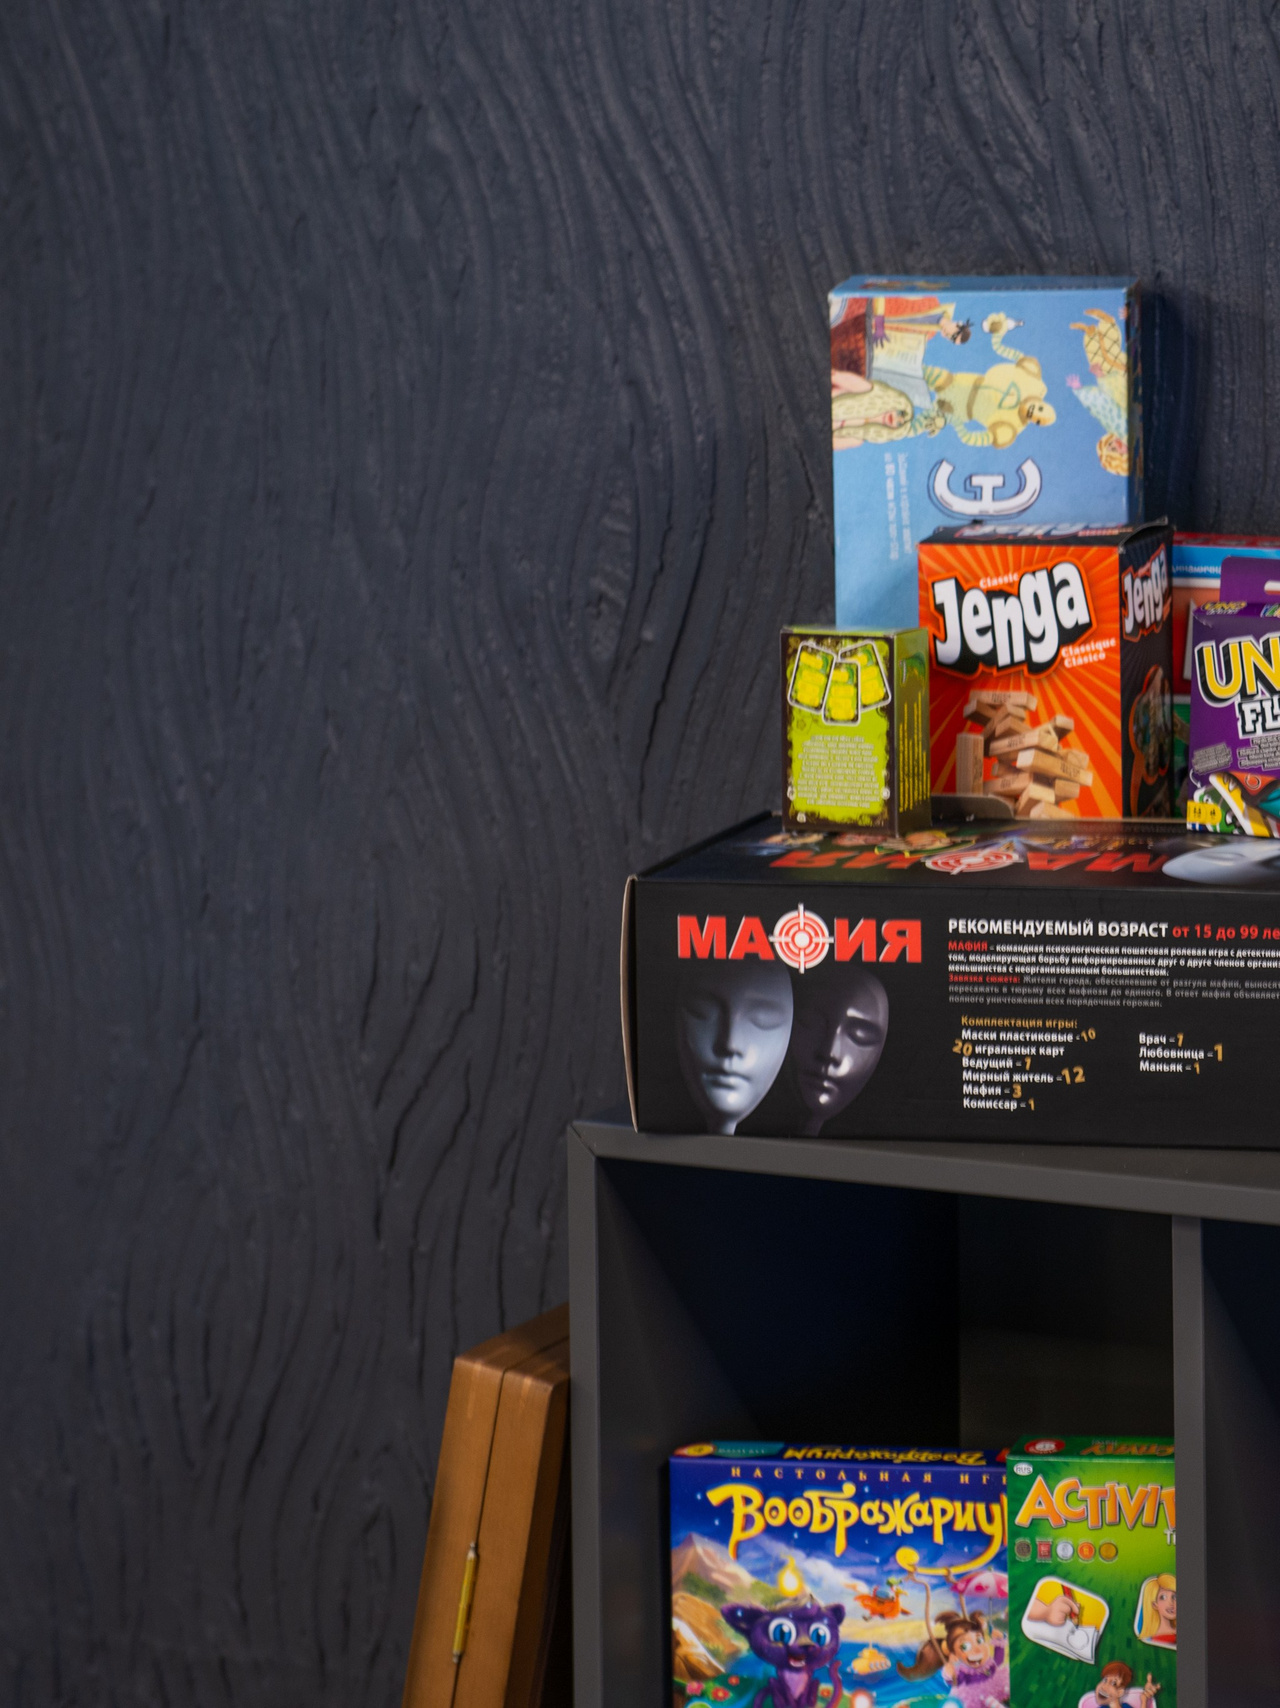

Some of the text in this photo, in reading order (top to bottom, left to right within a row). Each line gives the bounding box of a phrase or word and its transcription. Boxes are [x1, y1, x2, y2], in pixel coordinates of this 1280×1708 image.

[979, 572, 1019, 589] Classic
[1124, 549, 1168, 634] Jenga
[933, 561, 1091, 668] Jenga
[1061, 638, 1116, 658] Classique
[1064, 650, 1106, 668] Clásico
[948, 917, 1093, 937] РЕКОМЕНДУЕМЫЙ
[1098, 921, 1168, 938] ВОЗРАСТ
[1172, 925, 1190, 937] от
[1195, 924, 1211, 938] 15
[1216, 926, 1236, 940] до
[1240, 925, 1258, 939] 99
[948, 940, 988, 952] МАФИЯ
[996, 944, 1044, 954] командная
[1046, 944, 1119, 955] психологическая
[1121, 945, 1168, 956] пошаговая
[1171, 947, 1207, 957] ролевая
[1209, 948, 1228, 958] игра
[969, 954, 1036, 965] моделирующая
[1038, 954, 1069, 966] борьбу
[1072, 955, 1156, 966] информированных
[1158, 958, 1177, 968] друг
[1187, 960, 1212, 969] друге
[1214, 960, 1245, 968] членов
[948, 964, 1007, 974] меньшинства
[1015, 965, 1100, 976] неорганизованным
[1101, 966, 1169, 977] большинством.
[948, 973, 983, 983] Завязка
[986, 974, 1020, 984] сюжета:
[1023, 975, 1056, 985] Жители
[1059, 976, 1092, 987] города,
[1095, 977, 1157, 987] обессилевшие
[1173, 979, 1207, 989] разгула
[949, 985, 999, 995] пересажать
[1011, 986, 1043, 996] тюрьму
[1047, 986, 1066, 995] всех
[1069, 986, 1107, 997] мафиози
[1110, 988, 1121, 997] до
[1175, 989, 1198, 998] ответ
[1202, 989, 1231, 999] мафия
[1234, 989, 1280, 1000] объявляет
[949, 995, 984, 1004] полного
[986, 995, 1044, 1006] уничтожения
[1046, 997, 1065, 1005] всех
[1066, 997, 1121, 1008] порядочных
[961, 1016, 1078, 1030] Комплектация игры:
[962, 1029, 997, 1042] Маски
[1000, 1030, 1074, 1043] пластиковые
[1139, 1033, 1166, 1046] Врач
[952, 1039, 1065, 1057] 20 игральных карт
[1139, 1043, 1223, 1062] Любовница 1
[962, 1056, 1013, 1070] Ведущий
[1140, 1060, 1183, 1073] Маньяк
[962, 1065, 1086, 1085] Мирный житель 12
[963, 1083, 1022, 1099] Мафия 3
[963, 1098, 1035, 1111] Комиссар 1
[730, 1467, 933, 1484] НАСТОЛЬНАЯ
[706, 1481, 1007, 1575] Воображариу
